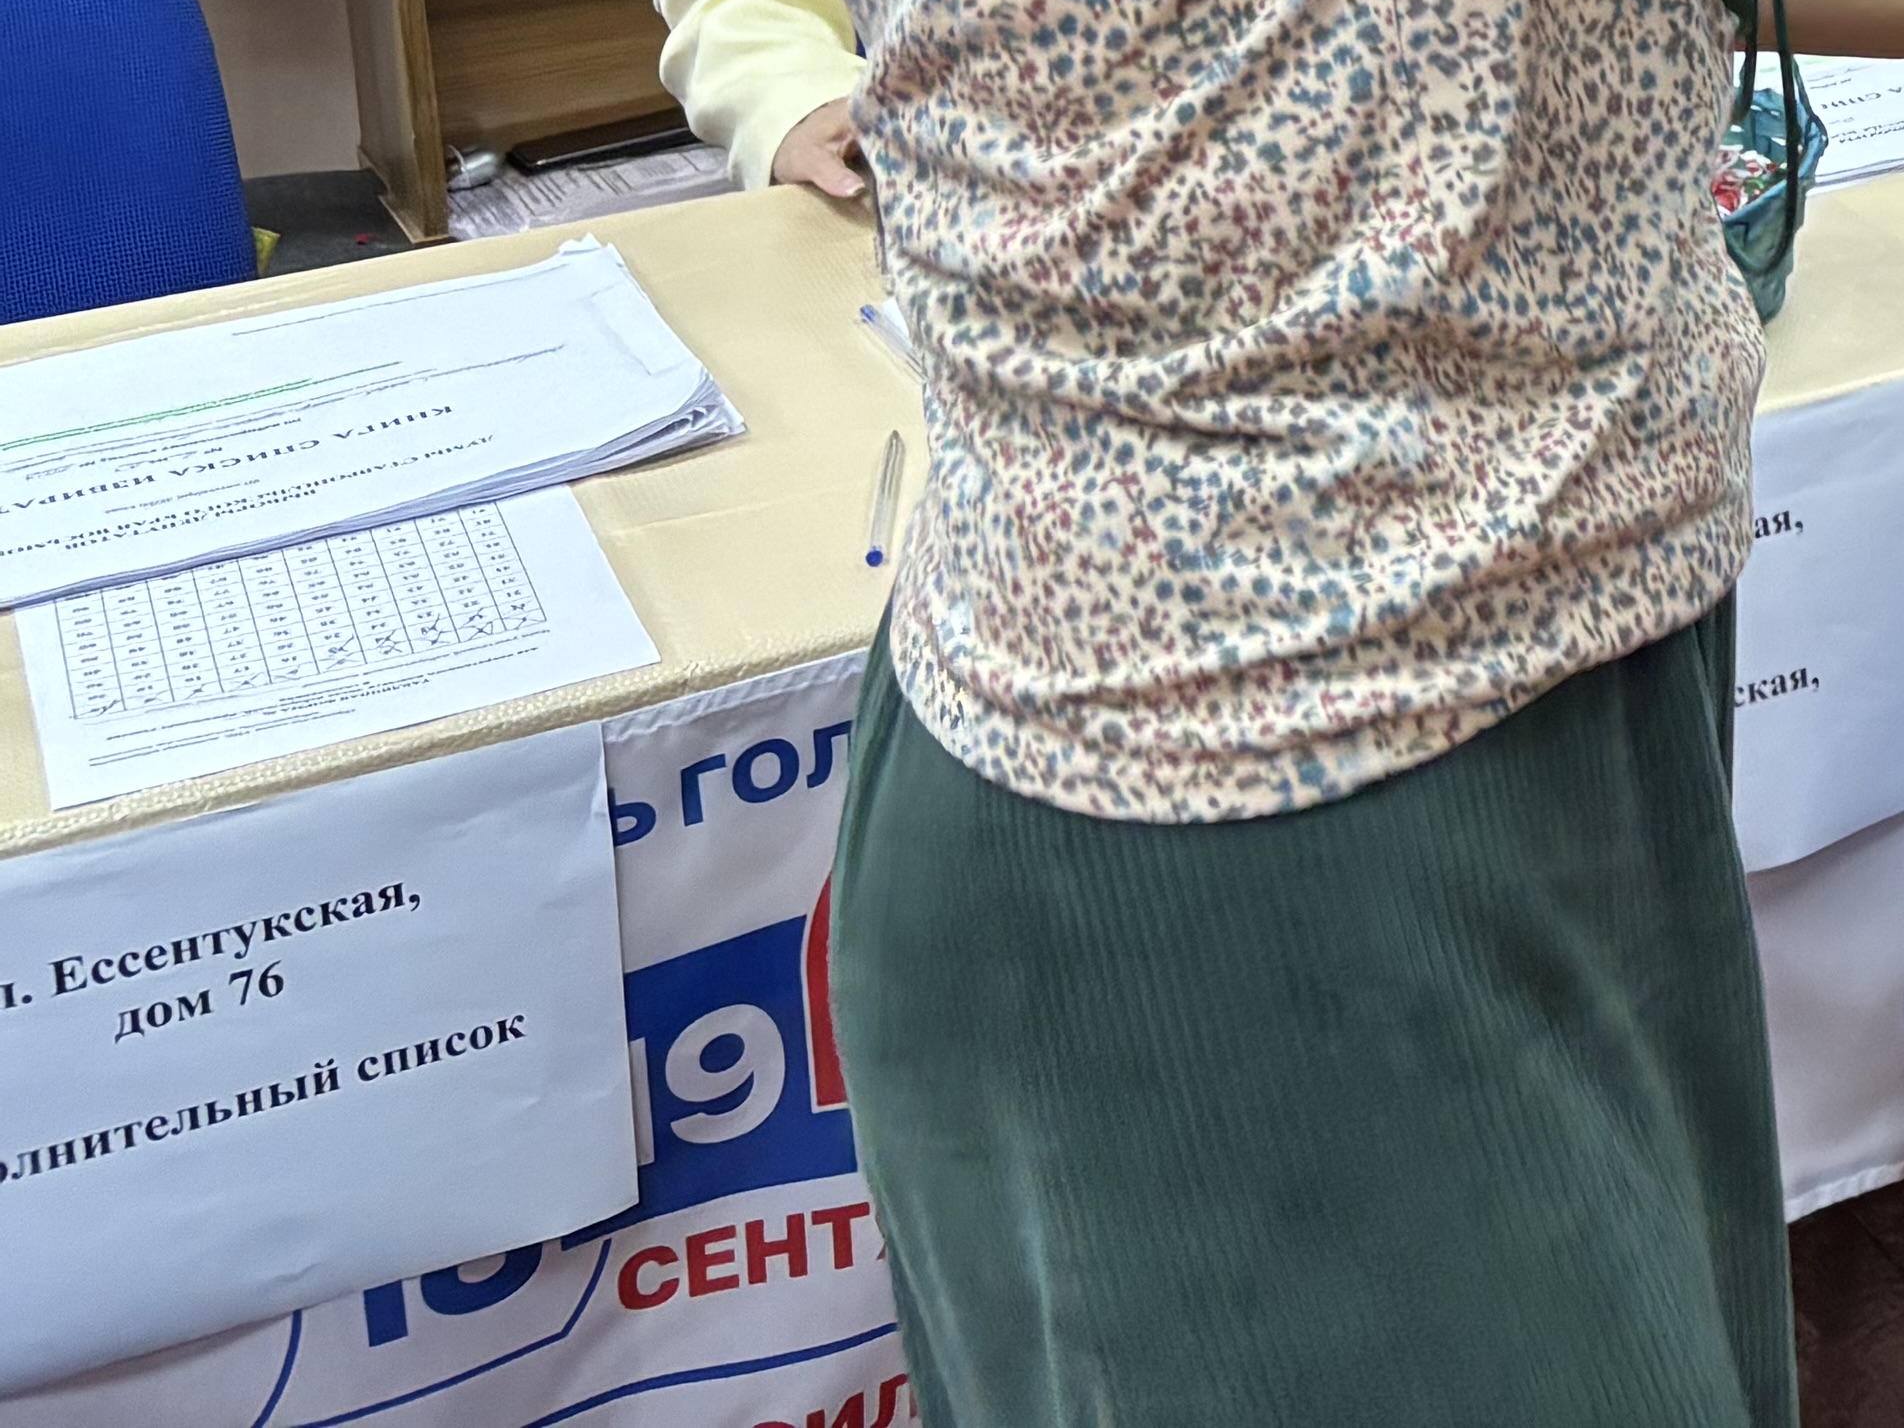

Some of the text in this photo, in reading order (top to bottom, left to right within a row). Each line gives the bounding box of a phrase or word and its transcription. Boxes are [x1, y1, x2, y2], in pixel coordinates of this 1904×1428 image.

[168, 439, 320, 477] СПИСКА
[332, 405, 452, 440] КНИГА
[49, 880, 422, 997] Ессентукская,
[114, 960, 286, 1045] дом 76
[357, 1013, 526, 1082] список
[617, 1201, 887, 1311] СЕНТ
